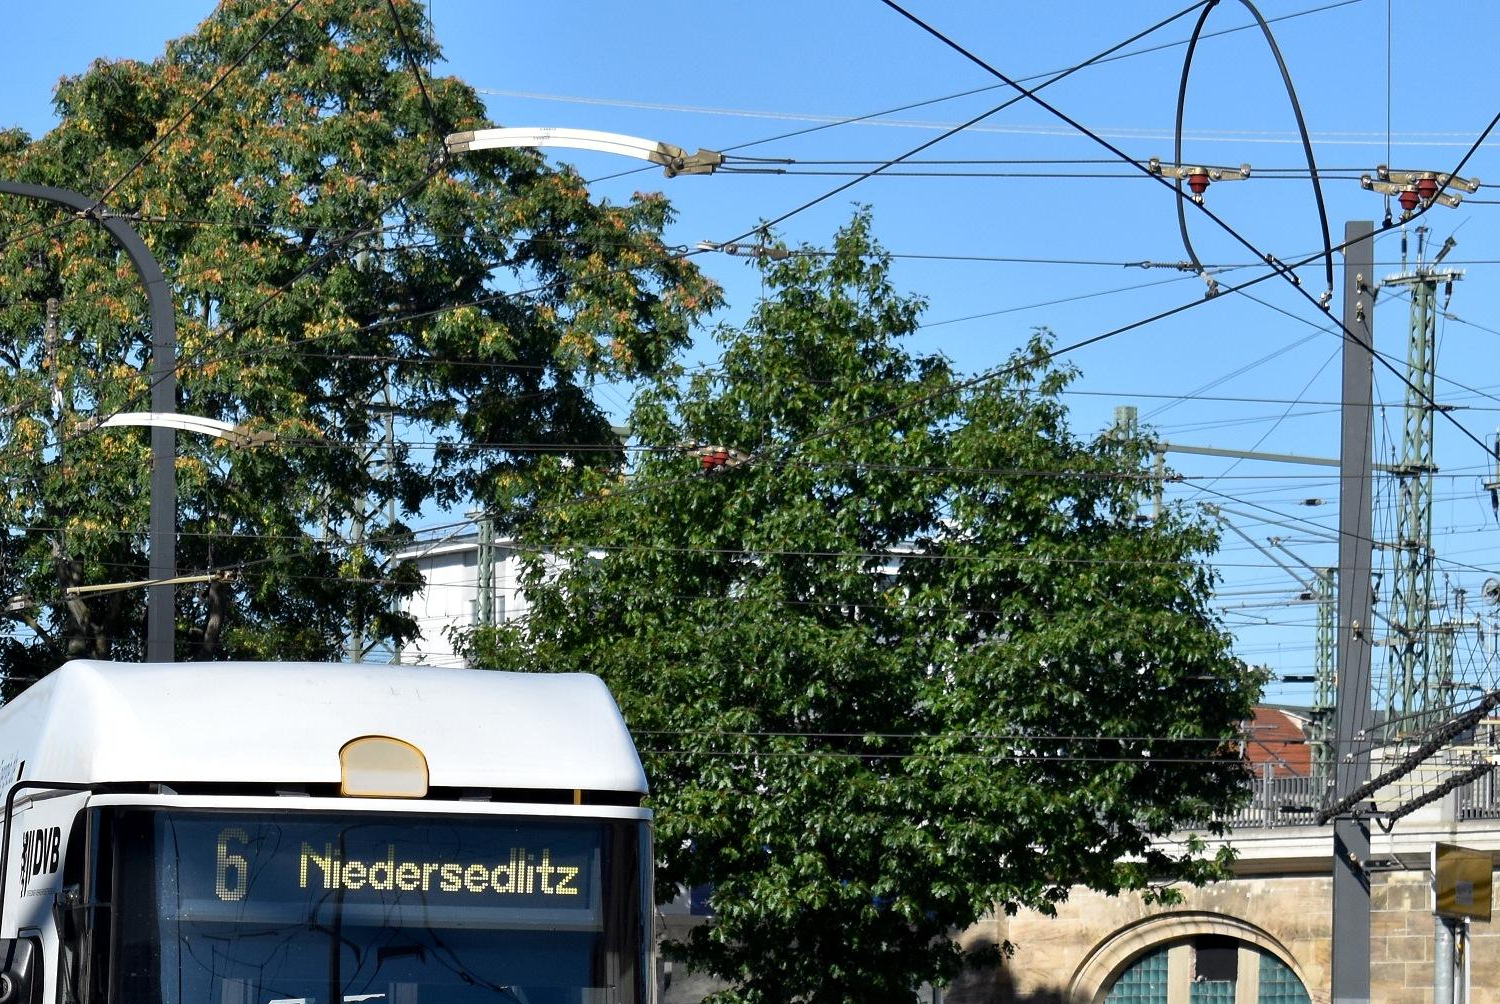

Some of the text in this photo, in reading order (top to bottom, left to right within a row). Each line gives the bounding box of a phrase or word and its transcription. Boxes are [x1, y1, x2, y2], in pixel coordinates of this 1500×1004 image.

[32, 826, 61, 876] DVB
[215, 826, 580, 902] 6 Niedersedlitz
